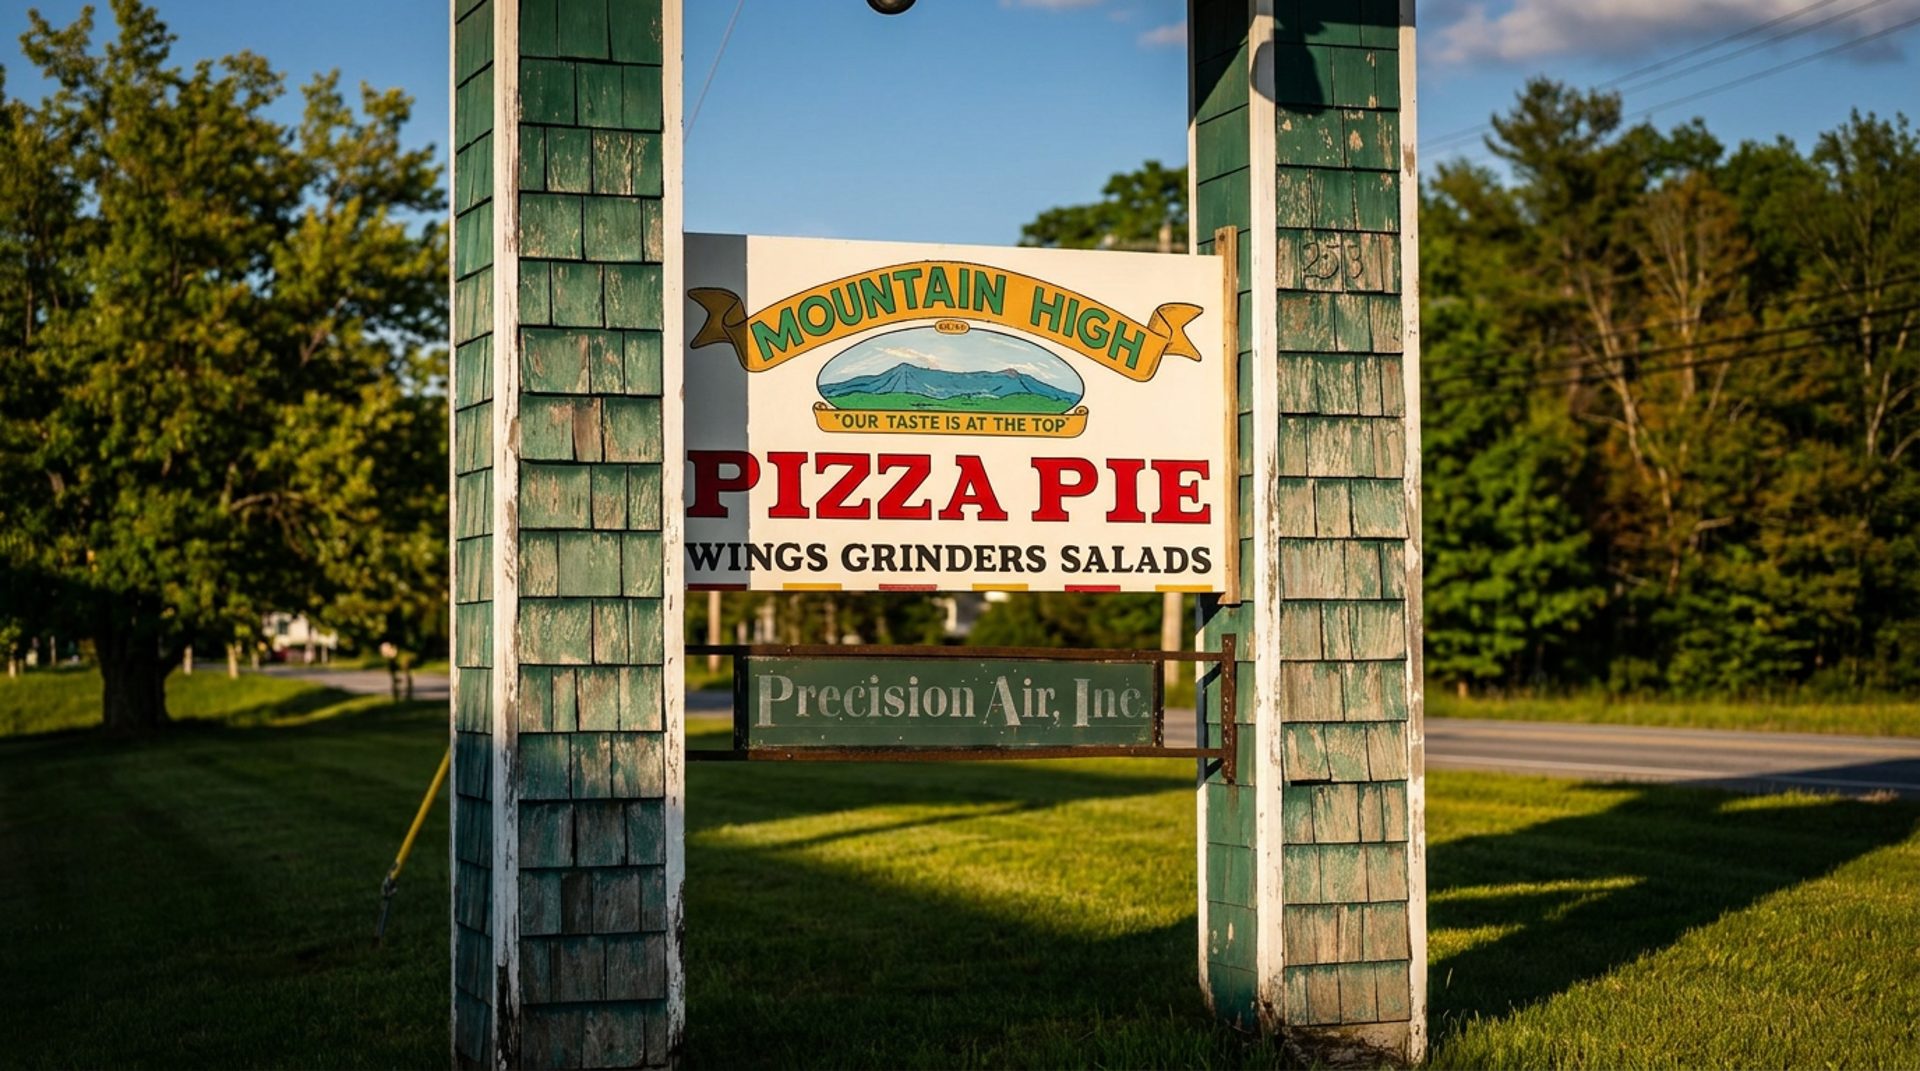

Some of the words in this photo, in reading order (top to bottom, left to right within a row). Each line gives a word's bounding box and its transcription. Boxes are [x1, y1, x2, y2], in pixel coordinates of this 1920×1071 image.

[750, 266, 1006, 361] MOUNTAIN
[1030, 287, 1146, 370] HIGH
[886, 414, 940, 430] TASTE
[945, 415, 961, 430] IS
[966, 416, 987, 431] AT
[993, 417, 1026, 432] THE
[686, 450, 1008, 521] PIZZA
[1031, 457, 1211, 524] PIE
[685, 542, 828, 572] WINGS
[841, 543, 1046, 573] GRINDERS
[1061, 545, 1212, 574] SALADS
[754, 673, 977, 727] Precision
[984, 675, 1061, 727] Air,
[1073, 677, 1150, 727] Inc.
